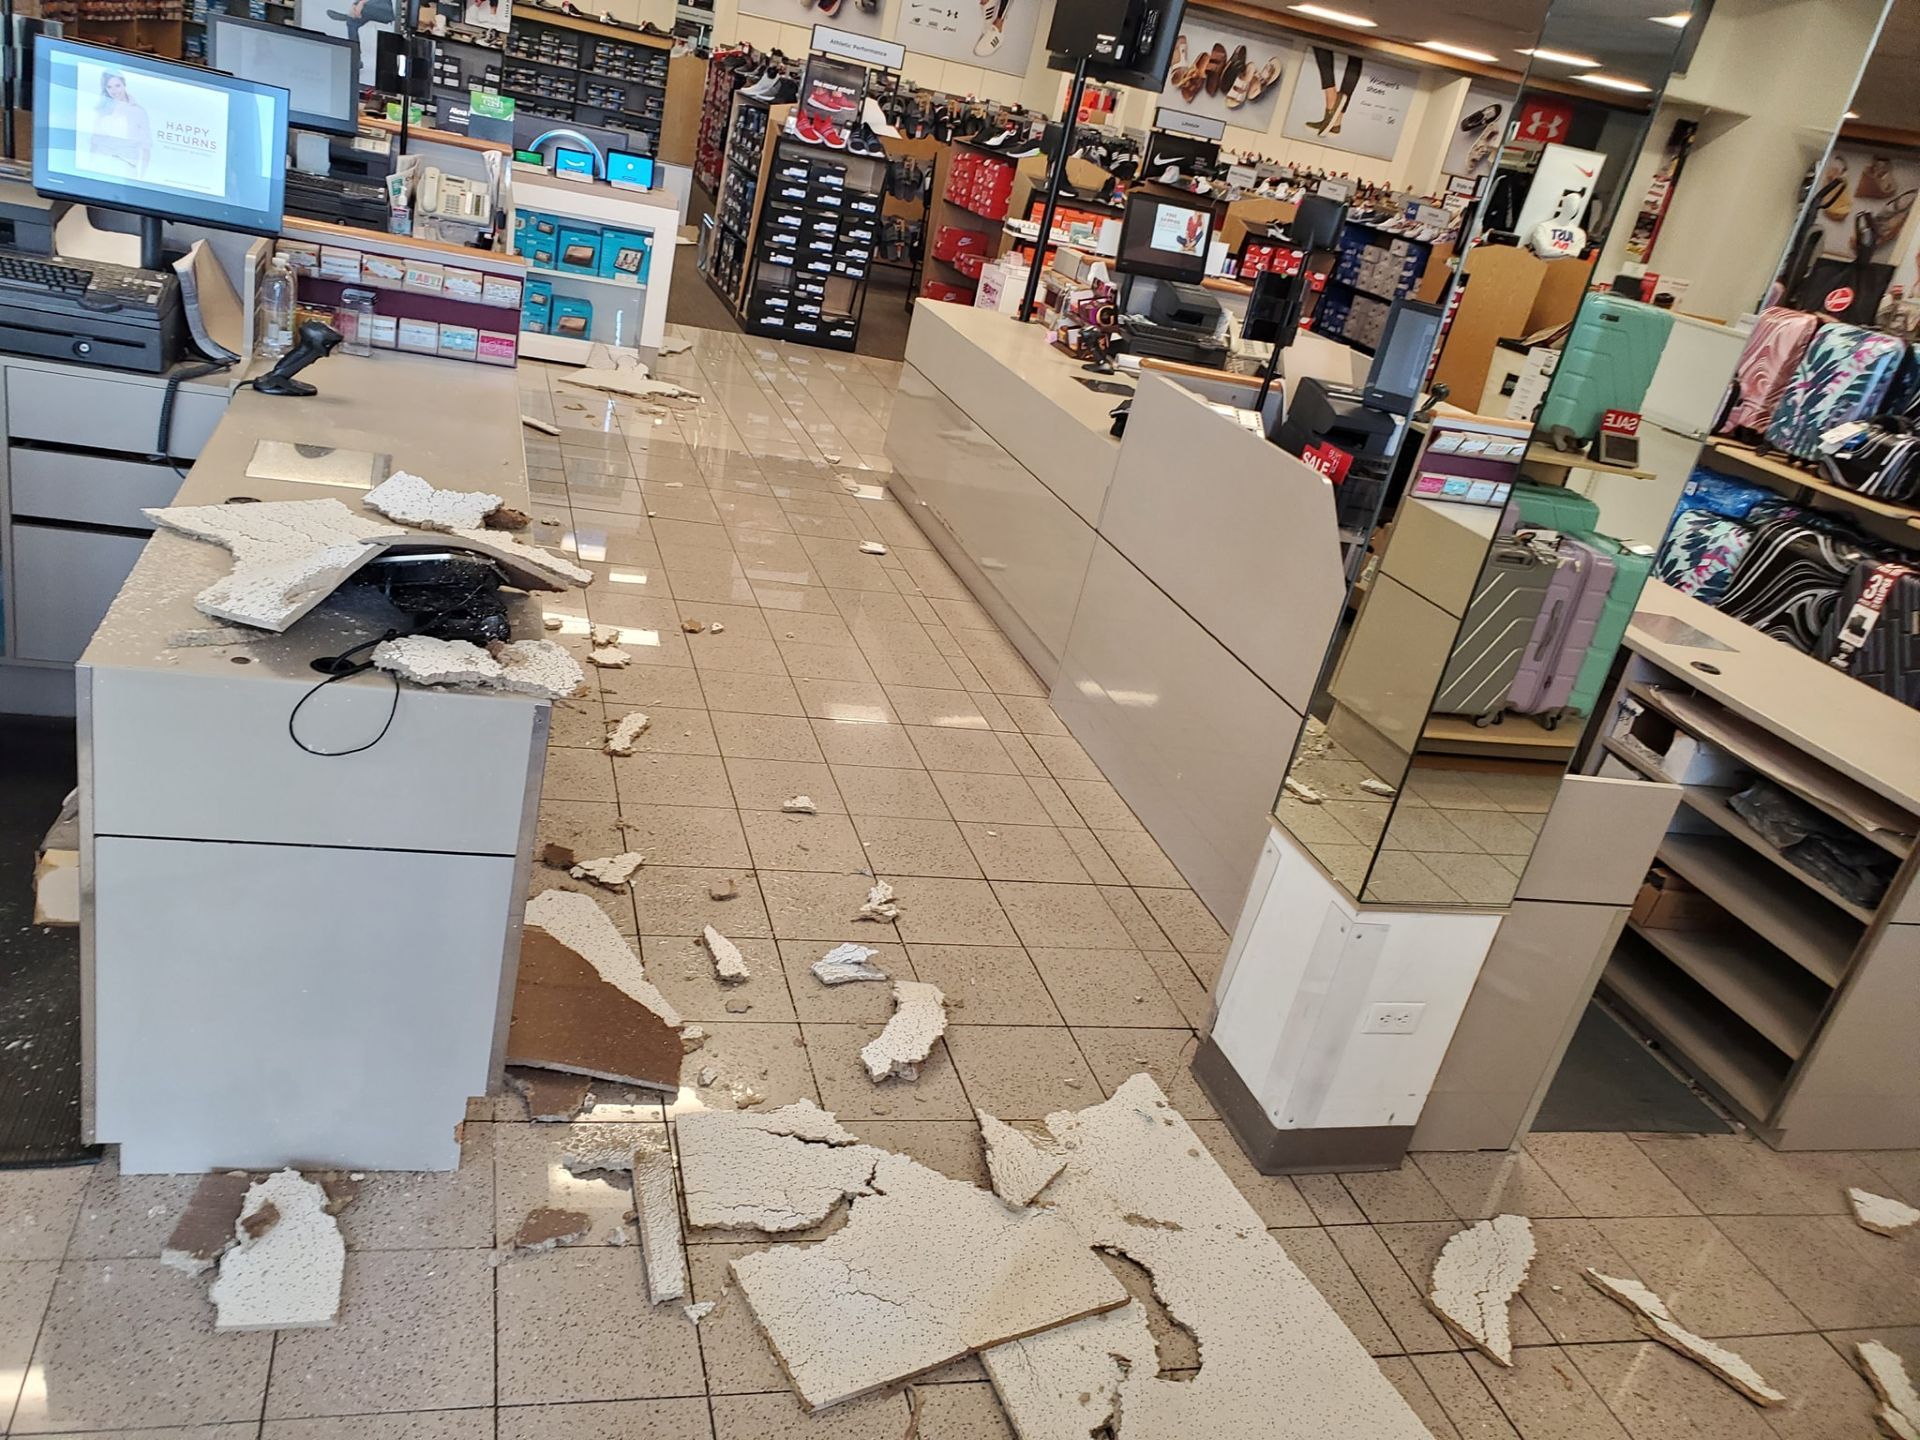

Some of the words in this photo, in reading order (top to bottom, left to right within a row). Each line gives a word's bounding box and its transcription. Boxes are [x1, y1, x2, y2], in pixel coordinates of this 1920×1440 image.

[829, 38, 851, 49] Athletic
[852, 44, 888, 57] Performance
[166, 121, 210, 137] HAPPY
[156, 130, 217, 150] RETURNS
[1302, 451, 1331, 474] SALE
